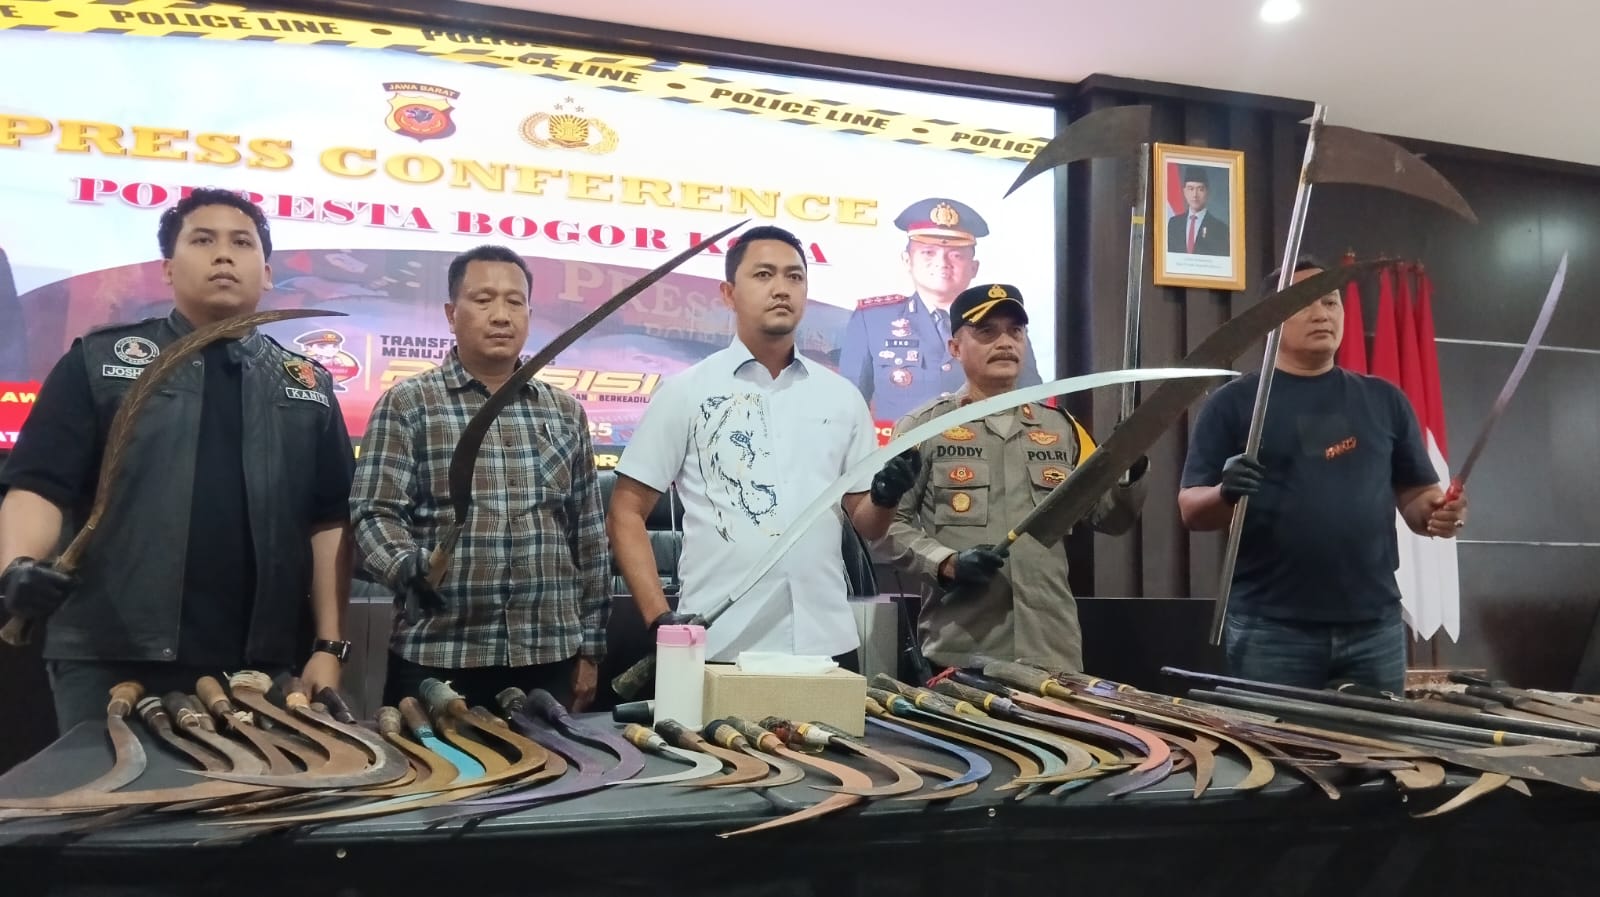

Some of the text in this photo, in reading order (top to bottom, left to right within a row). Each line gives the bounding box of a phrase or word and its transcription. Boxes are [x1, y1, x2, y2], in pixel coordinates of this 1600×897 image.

[109, 9, 342, 36] POLICE LINE
[569, 62, 642, 84] LINE
[389, 83, 456, 98] JAWA BARAT
[710, 87, 890, 130] POLICE LINE
[0, 113, 878, 226] PRESS CONFERENCE
[454, 210, 673, 252] BOGOR
[381, 346, 448, 359] MENUJ
[598, 394, 652, 404] BERKEADIL
[937, 445, 983, 458] DODDY
[1028, 450, 1067, 462] POLRI
